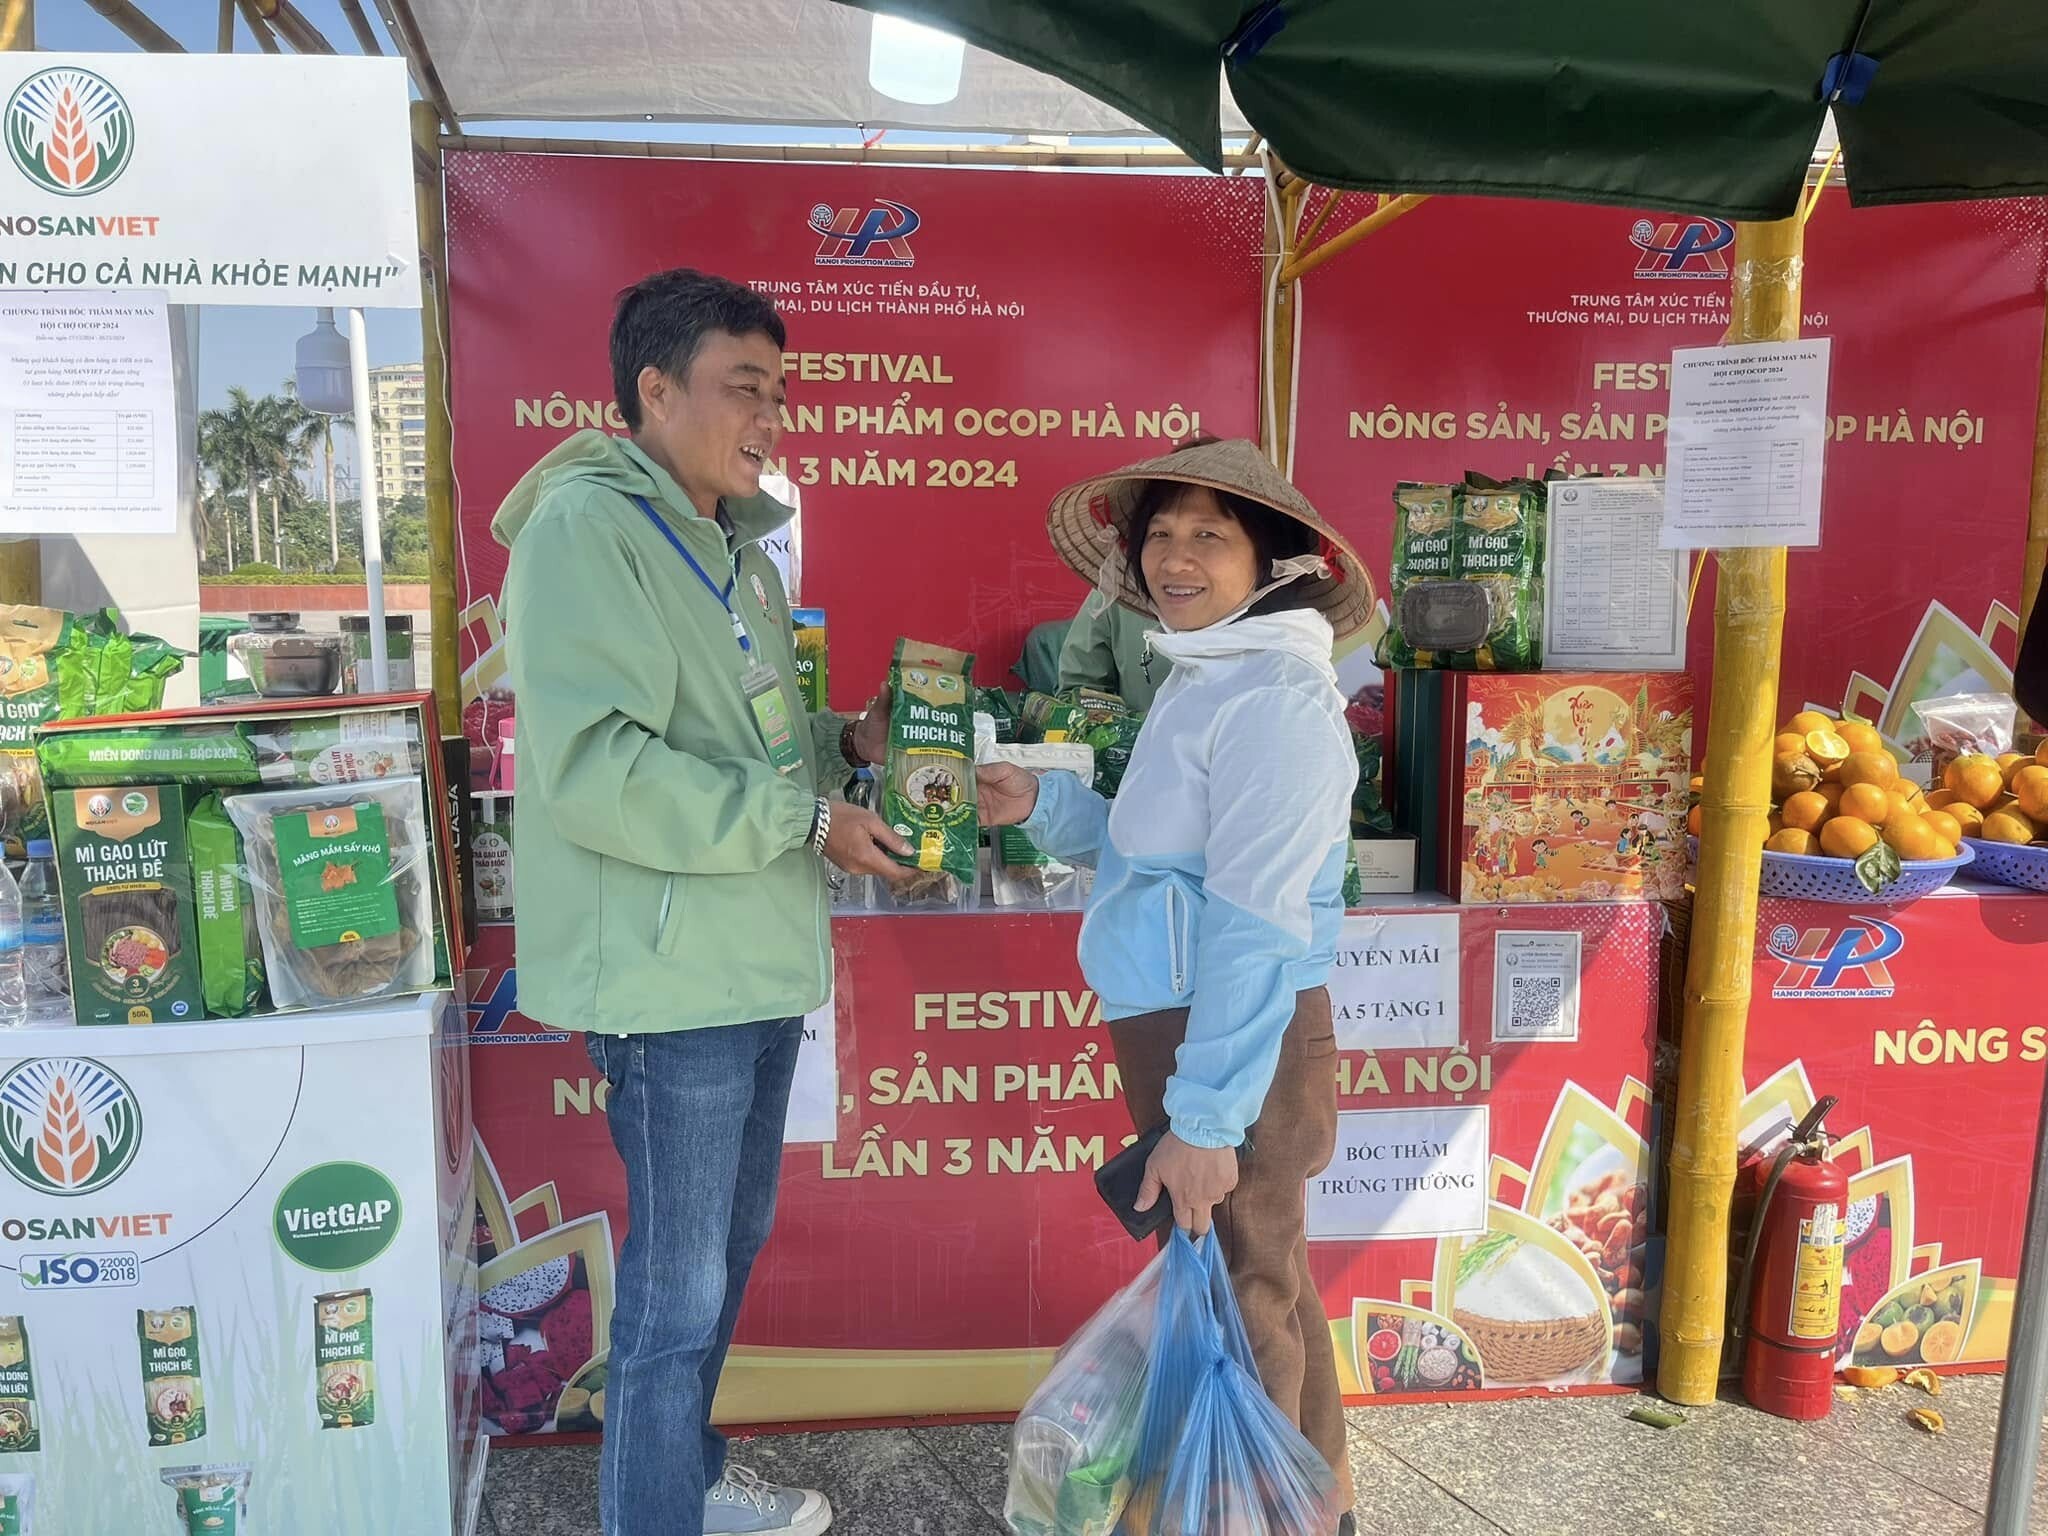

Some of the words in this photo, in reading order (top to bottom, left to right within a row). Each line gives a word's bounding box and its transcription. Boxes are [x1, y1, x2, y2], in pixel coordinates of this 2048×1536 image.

[26, 261, 87, 286] CHO
[95, 256, 133, 285] CẢ
[142, 258, 202, 286] NHÀ
[211, 258, 289, 287] KHỎE
[815, 257, 840, 265] HANOI
[840, 258, 883, 266] PROMOTION
[884, 259, 914, 267] AGENCY
[748, 280, 801, 294] TRUNG
[807, 279, 838, 295] TÂM
[843, 280, 874, 295] XÚC
[879, 280, 913, 297] TIẾN
[918, 280, 951, 298] ĐẦU
[955, 284, 980, 299] TƯ,
[774, 300, 806, 314] MẠI,
[811, 301, 832, 312] DU
[843, 301, 872, 316] LỊCH
[877, 298, 929, 315] THÀNH
[935, 298, 967, 316] PHỐ
[971, 300, 992, 316] HÀ
[997, 301, 1025, 319] NỘI
[1571, 295, 1621, 307] TRUNG
[1625, 293, 1655, 307] TÂM
[1659, 292, 1688, 307] XÚC
[1694, 291, 1726, 308] TIẾN
[2, 308, 39, 316] CHƯƠNG
[41, 307, 68, 316] TRÌNH
[88, 307, 114, 316] THĂM
[115, 308, 134, 316] MAY
[135, 306, 155, 316] MẮN
[1527, 311, 1597, 325] THƯƠNG
[1601, 311, 1624, 327] MẠI,
[1629, 312, 1649, 325] DU
[1654, 312, 1685, 328] LỊCH
[1690, 309, 1730, 325] THÀN
[1803, 313, 1829, 328] NỘI
[39, 320, 57, 330] HỘI
[57, 321, 76, 330] CHỢ
[780, 352, 954, 384] FESTIVAL
[1682, 359, 1715, 369] CHƯƠNG
[1717, 358, 1739, 367] TRÌNH
[1757, 355, 1780, 365] THĂM
[1781, 354, 1799, 362] MAY
[1593, 362, 1671, 391] FEST
[1713, 371, 1728, 379] HỘI
[1728, 369, 1745, 378] CHỢ
[514, 391, 628, 428] NÔNG
[835, 391, 943, 435] PHẨM
[954, 407, 1062, 438] OCOP
[1072, 401, 1125, 439] HÀ
[1135, 403, 1200, 446] NỘI
[1349, 402, 1457, 440] NÔNG
[1465, 401, 1551, 446] SẢN,
[1560, 402, 1635, 441] SẢN
[1865, 408, 1915, 442] HÀ
[1923, 409, 1985, 451] NỘI
[799, 457, 820, 485] 3
[831, 450, 916, 487] NĂM
[926, 459, 1018, 488] 2024
[1425, 538, 1448, 554] GẠO
[1485, 536, 1509, 552] GẠO
[1462, 554, 1498, 570] THẠCH
[7, 703, 40, 722] GẠO
[910, 704, 928, 720] MÌ
[931, 709, 958, 727] GẠO
[0, 725, 26, 744] ẠCH
[901, 725, 947, 743] THẠCH
[88, 745, 119, 762] MIẾN
[120, 748, 151, 761] DONG
[76, 843, 95, 863] MÌ
[100, 843, 133, 864] GẠO
[138, 839, 168, 859] LỨT
[361, 843, 381, 854] KHÔ
[83, 863, 137, 884] THẠCH
[1336, 945, 1393, 967] UYẾN
[1399, 944, 1440, 965] MÃI
[132, 979, 140, 987] 3
[1773, 990, 1803, 998] HANOI
[1803, 989, 1857, 998] PROMOTION
[1858, 989, 1893, 997] AGENCY
[1356, 1004, 1366, 1019] 5
[1370, 1000, 1431, 1022] TẶNG
[1438, 1001, 1445, 1015] 1
[467, 1033, 528, 1043] PROMOTION
[528, 1032, 570, 1042] AGENCY
[1873, 1018, 2009, 1065] NÔNG
[868, 1051, 978, 1105] SẢN
[1404, 1047, 1491, 1101] NỘI
[822, 1123, 928, 1179] LẦN
[943, 1138, 972, 1175] 3
[987, 1124, 1106, 1174] NĂM
[1346, 1141, 1386, 1161] BỐC
[1391, 1140, 1448, 1159] THĂM
[1318, 1175, 1386, 1195] TRÚNG
[1391, 1171, 1475, 1193] THƯỞNG
[284, 1200, 392, 1232] VietGAP
[2, 1213, 173, 1241] OSANVIET
[39, 1257, 100, 1286] ISO
[100, 1257, 135, 1268] 22000
[101, 1268, 136, 1282] 2018
[325, 1332, 338, 1345] MÌ
[153, 1347, 166, 1359] MÌ
[167, 1346, 187, 1360] GẠO
[320, 1348, 351, 1360] THẠCH
[149, 1360, 180, 1373] THẠCH
